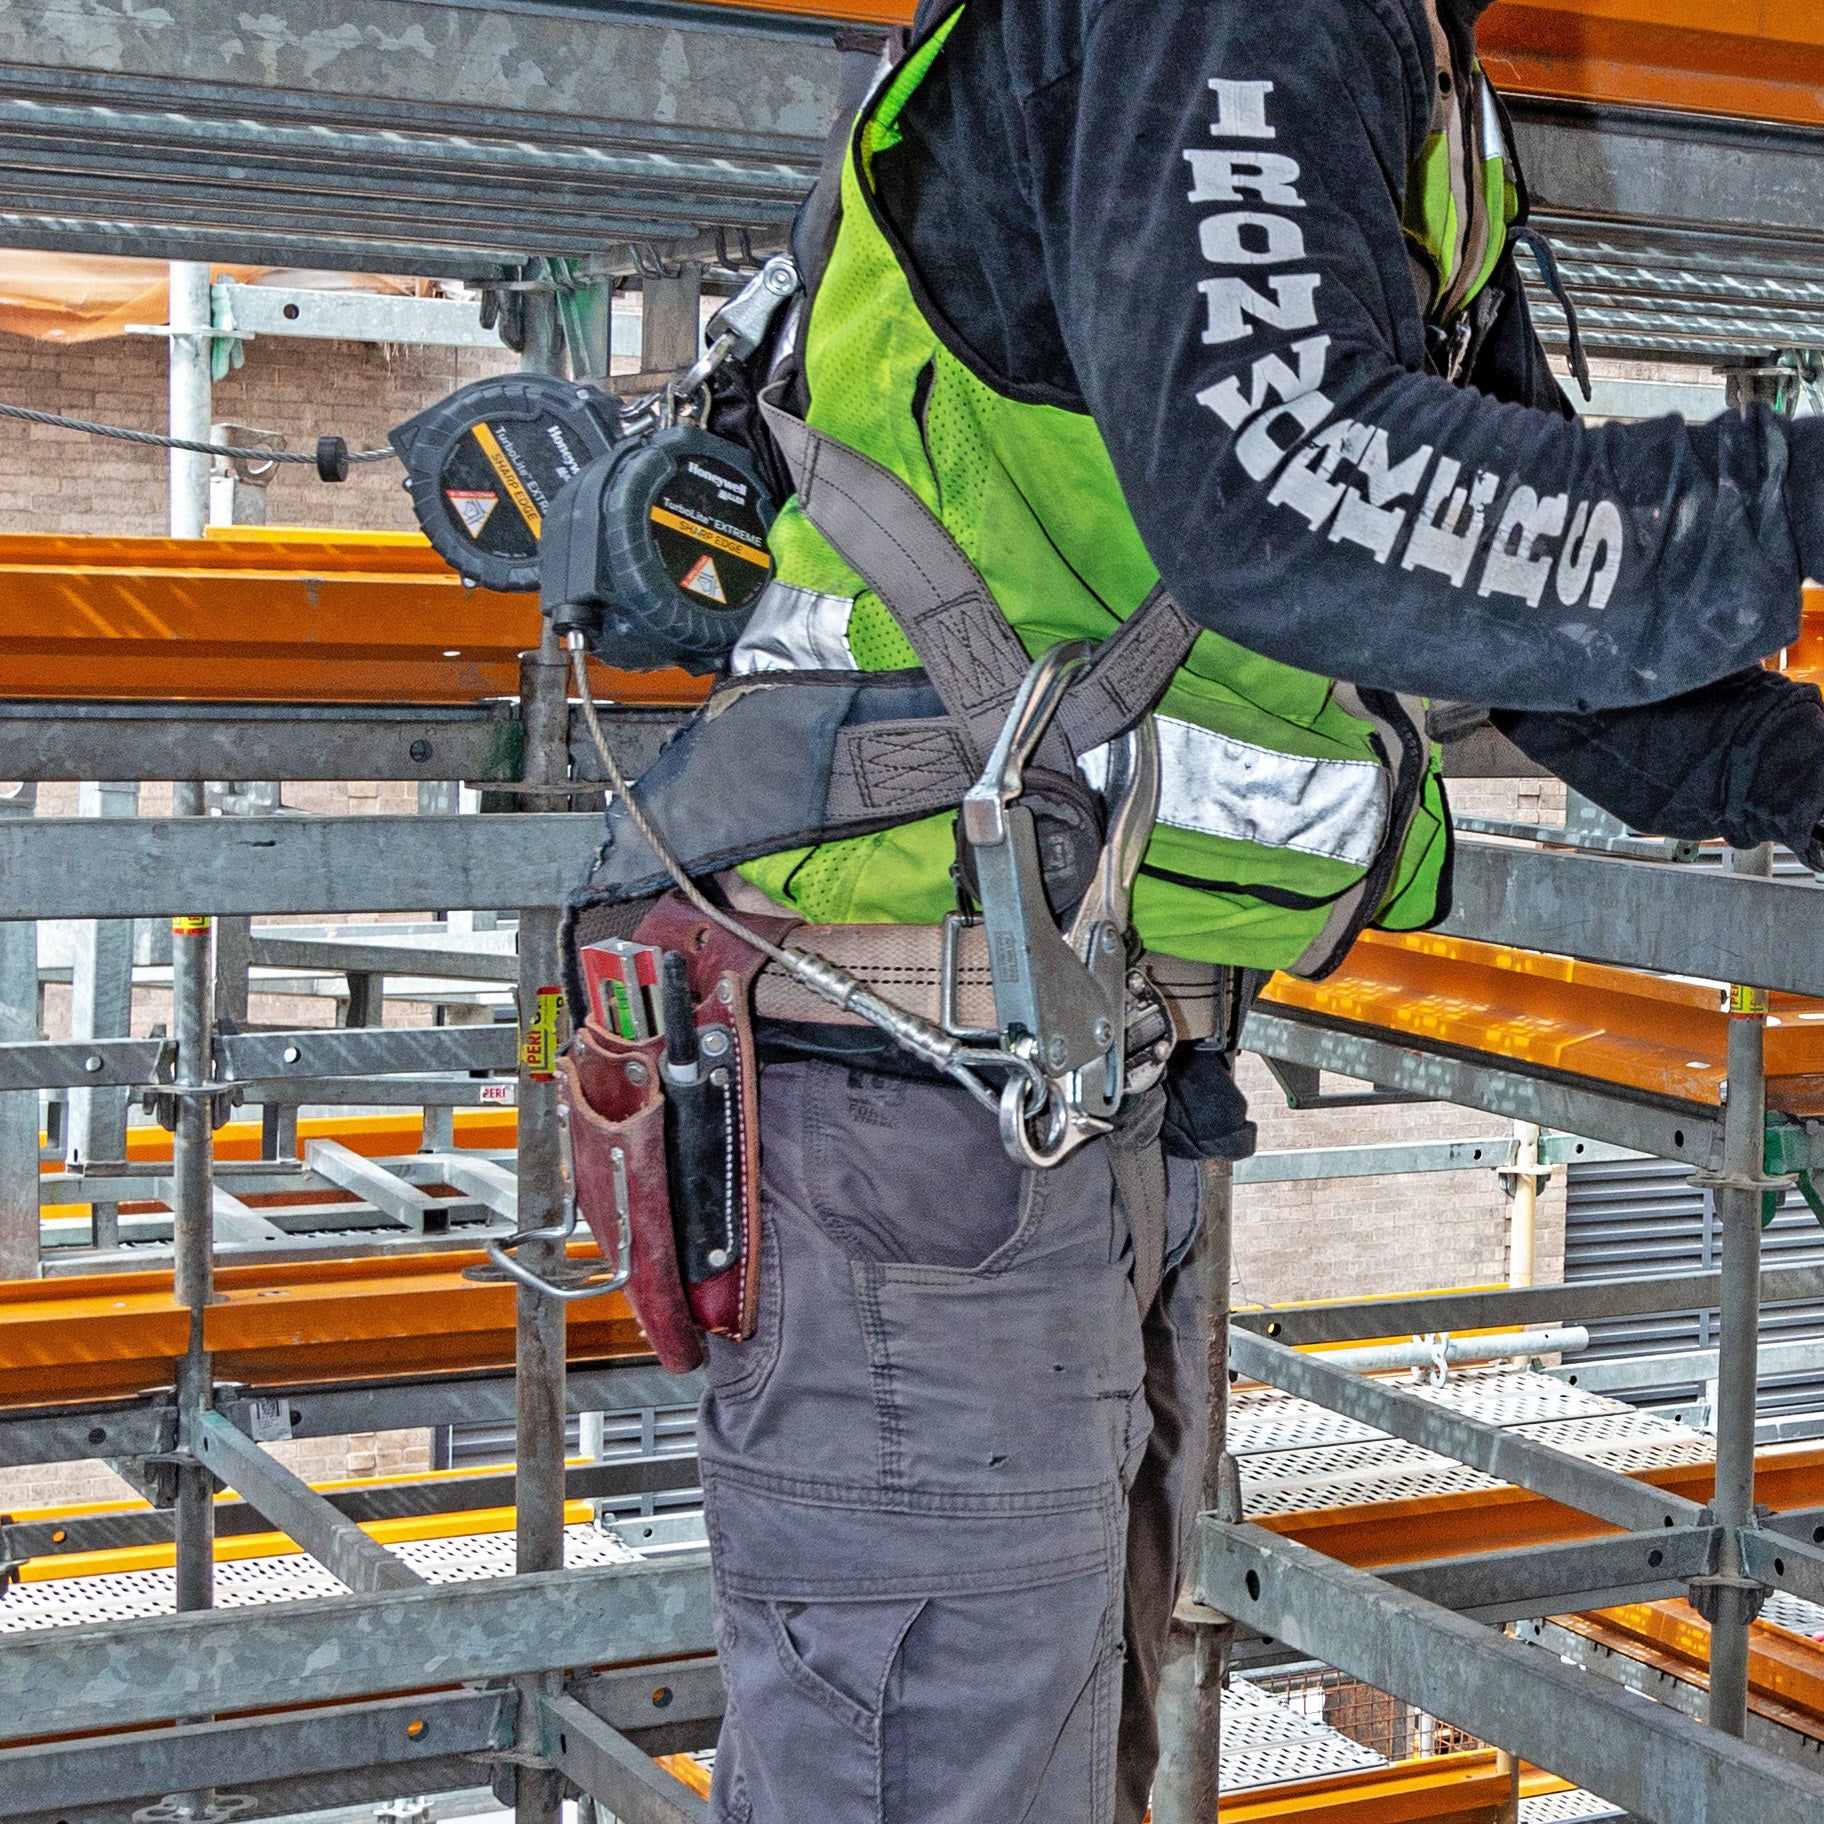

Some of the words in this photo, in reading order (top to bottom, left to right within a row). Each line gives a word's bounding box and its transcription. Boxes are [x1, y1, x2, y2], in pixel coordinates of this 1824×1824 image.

[1182, 77, 1623, 610] IRONWORKERS
[547, 425, 581, 475] Honeyw
[491, 453, 520, 491] SHARP
[513, 486, 539, 522] EDGE
[688, 462, 748, 496] Honeywell
[679, 520, 712, 542] SHARP
[713, 532, 743, 555] EDGE
[715, 519, 762, 547] EXTREME
[1731, 984, 1739, 1005] PER
[526, 1030, 542, 1065] PERI
[483, 1087, 506, 1099] PERI
